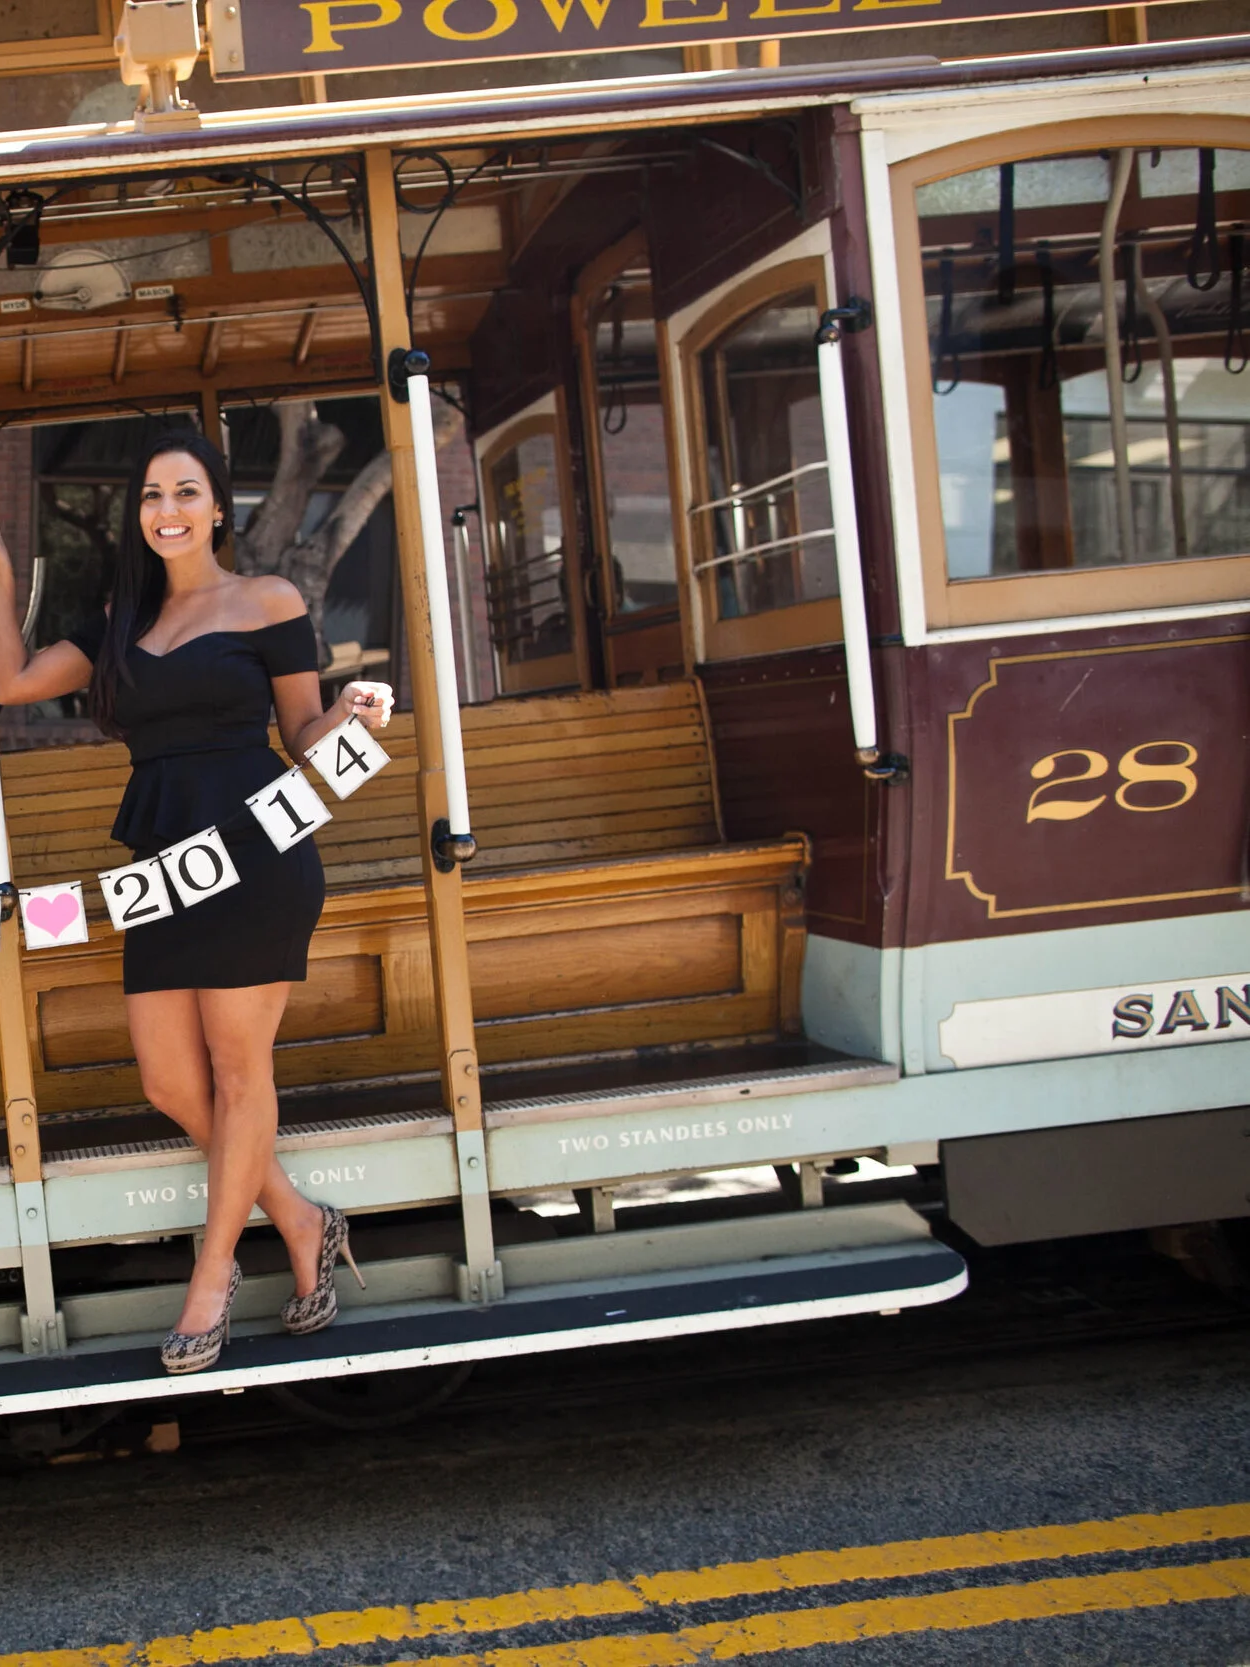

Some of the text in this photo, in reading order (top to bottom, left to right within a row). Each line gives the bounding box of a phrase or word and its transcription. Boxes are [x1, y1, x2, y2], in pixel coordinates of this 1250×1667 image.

[299, 0, 941, 53] POWE
[137, 287, 172, 298] MASON
[1026, 740, 1199, 824] 28
[1112, 984, 1250, 1040] SAN
[558, 1113, 793, 1154] TWO STANDEES ONLY
[125, 1187, 177, 1206] TWO
[309, 1165, 366, 1186] ONLY
